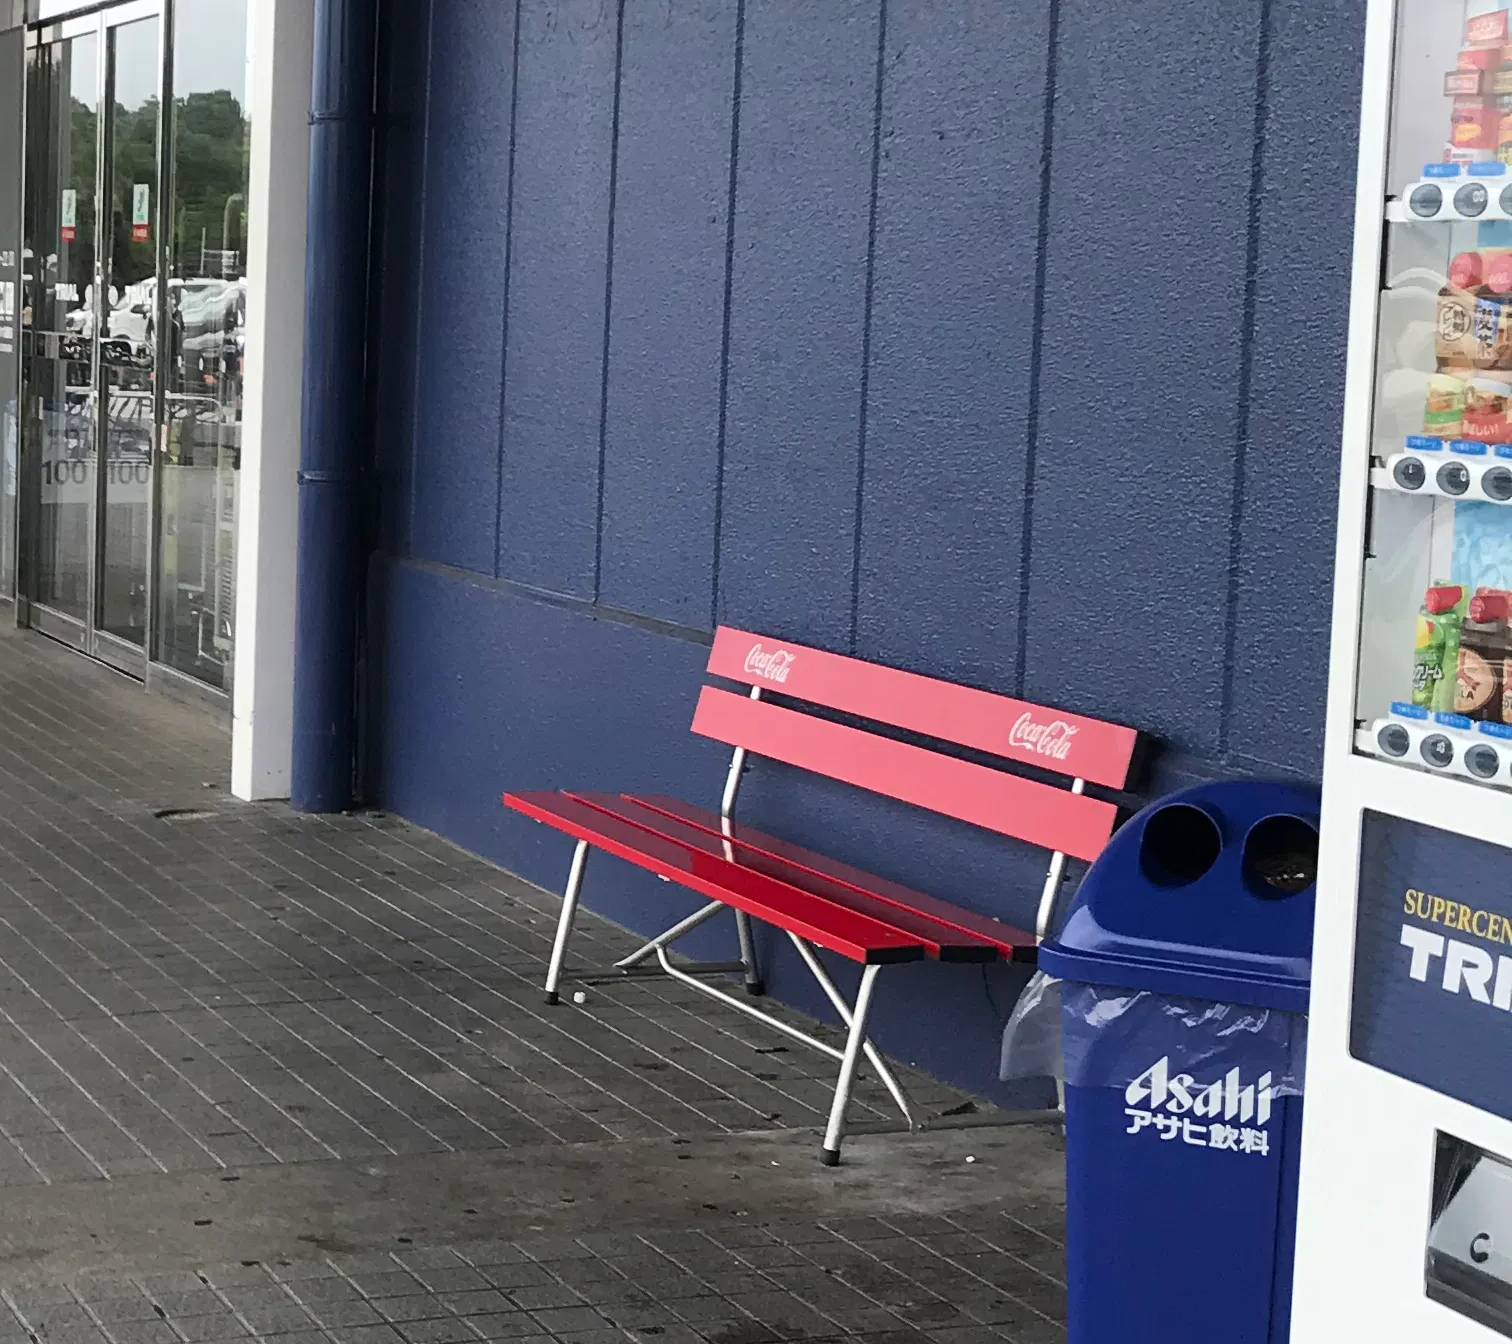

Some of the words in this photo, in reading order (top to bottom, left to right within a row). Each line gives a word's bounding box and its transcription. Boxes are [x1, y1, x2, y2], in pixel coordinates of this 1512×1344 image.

[1400, 923, 1512, 1014] TRI
[1124, 1056, 1272, 1126] Asahi
[1124, 1107, 1270, 1156] アサヒ飲料
